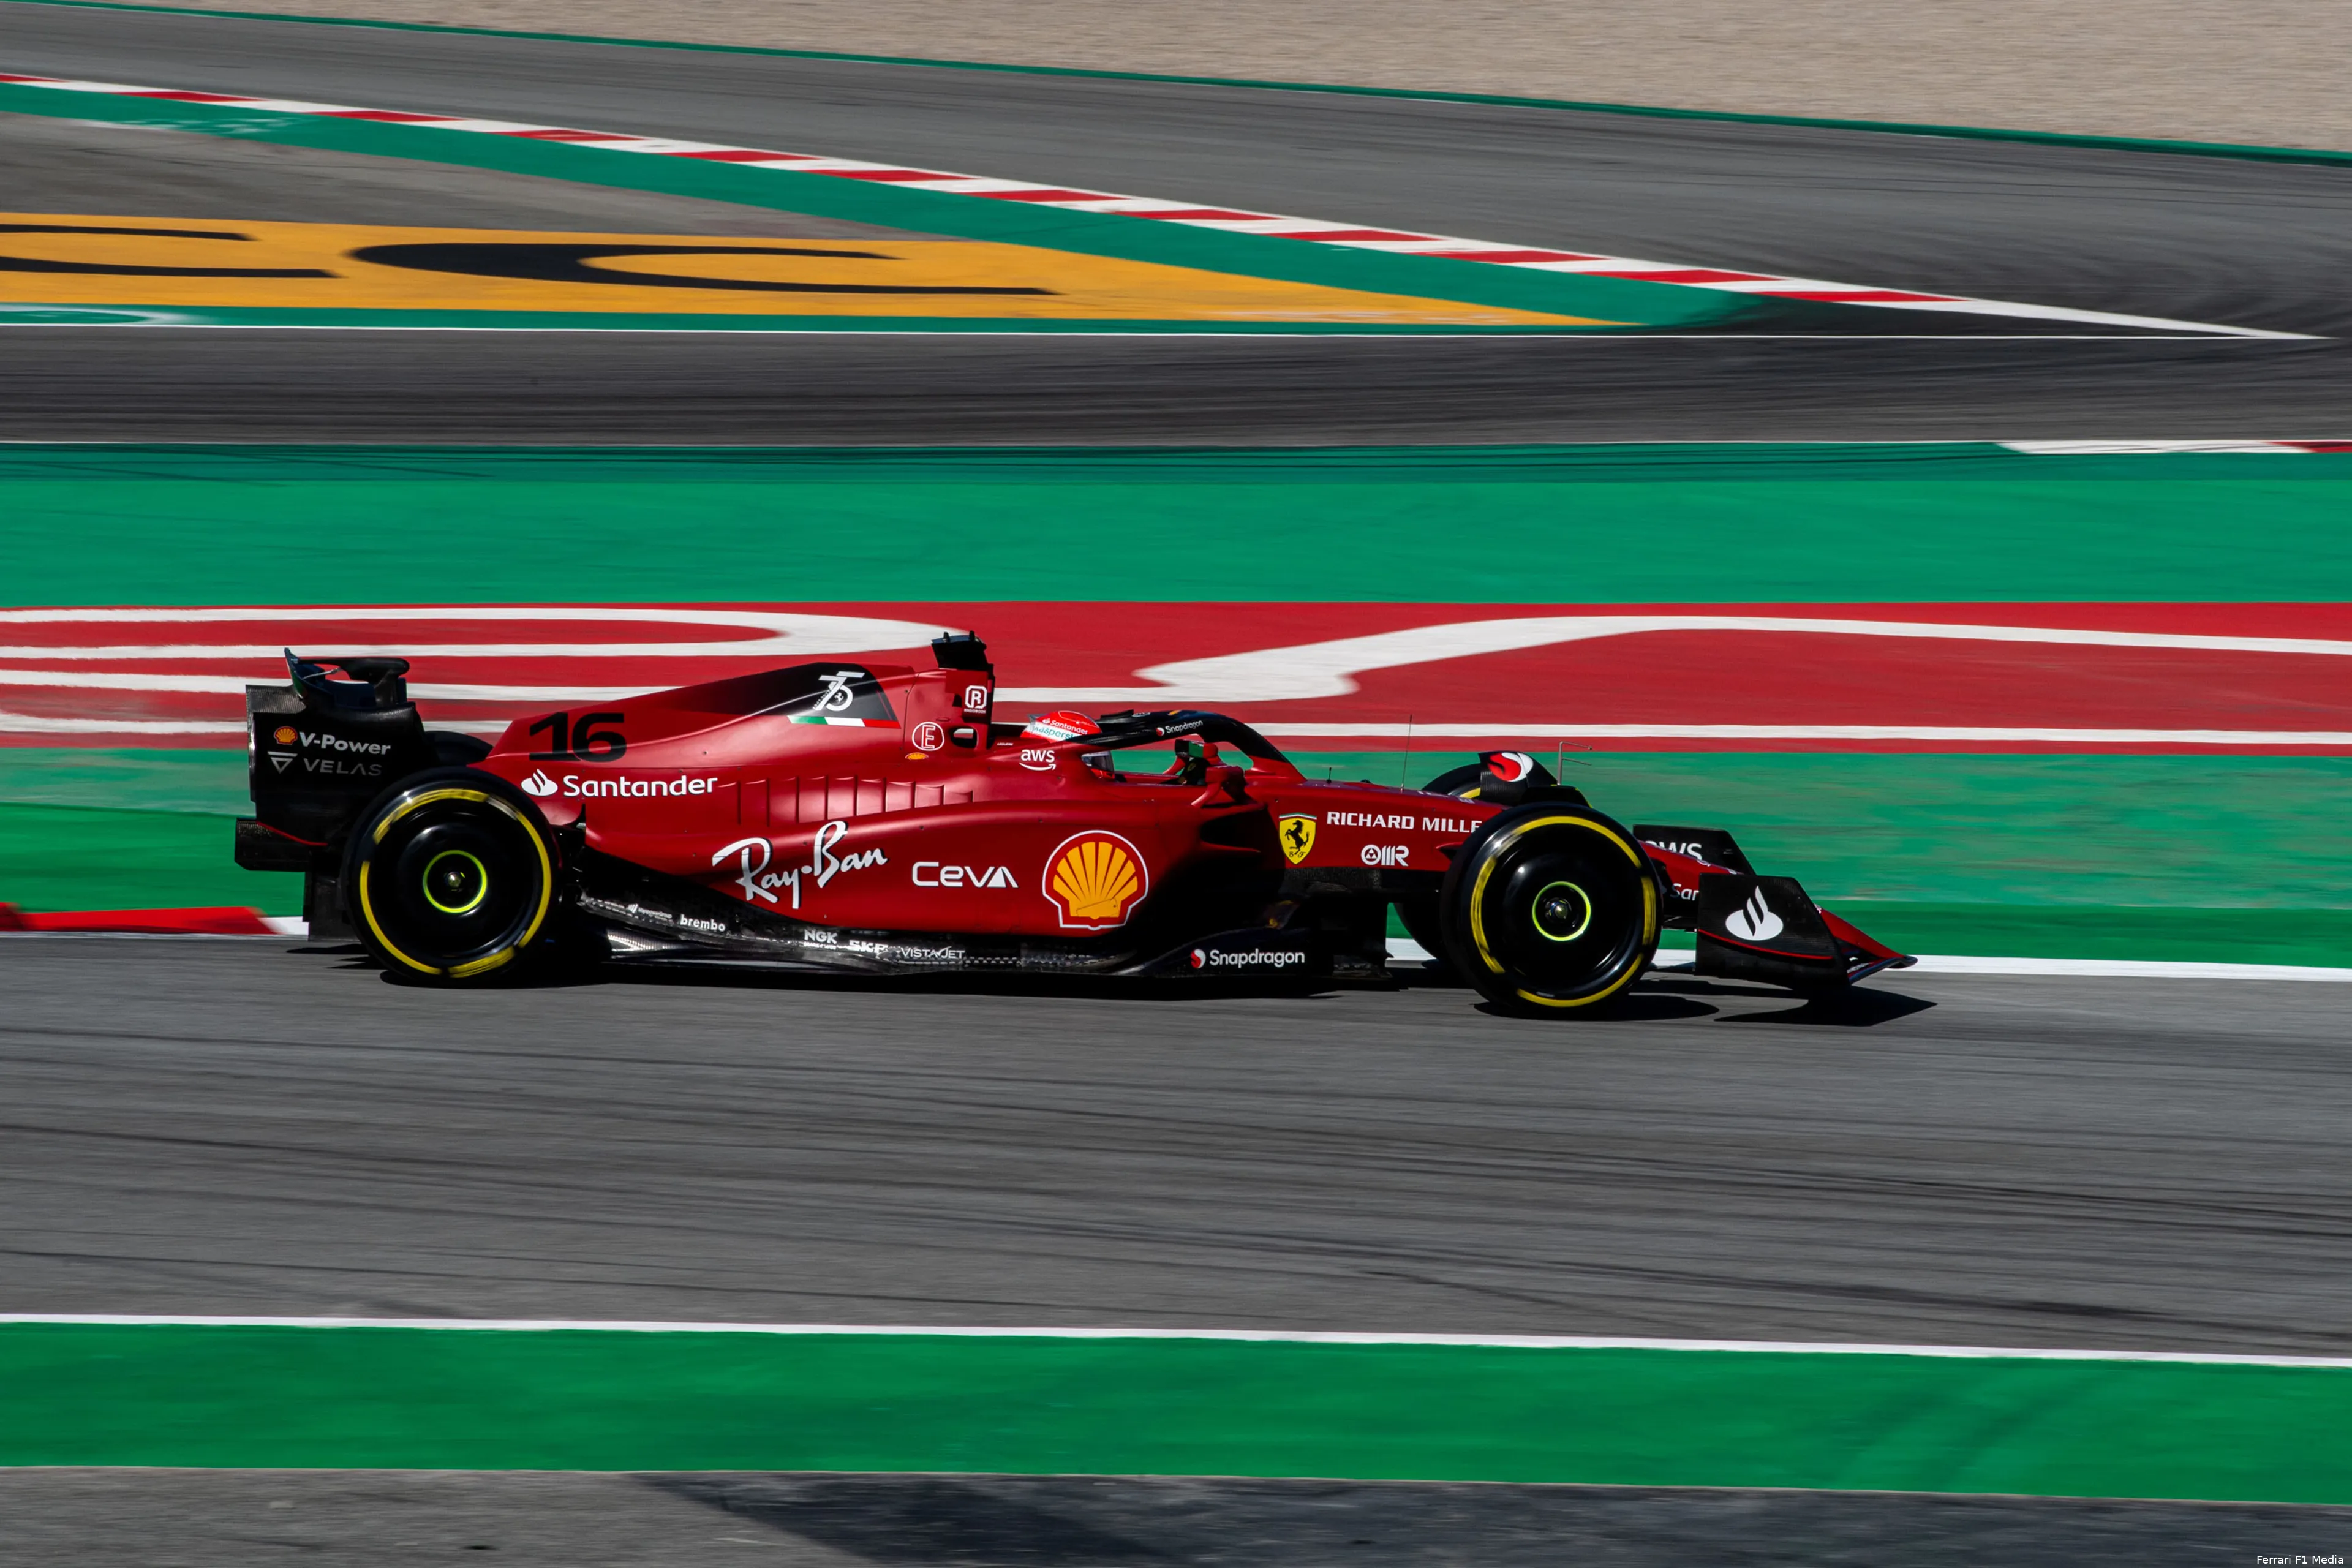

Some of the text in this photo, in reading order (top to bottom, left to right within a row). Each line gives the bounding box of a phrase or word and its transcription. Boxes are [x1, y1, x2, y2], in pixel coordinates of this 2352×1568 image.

[1050, 720, 1088, 736] Santander
[1165, 720, 1204, 734] Snapdragon
[300, 731, 391, 756] V-Power
[529, 712, 627, 763] 16
[1020, 749, 1055, 763] aws
[303, 758, 382, 776] VELAS
[563, 774, 718, 797] Santander
[1327, 811, 1415, 830] RICHARD
[680, 914, 726, 932] brembo
[804, 929, 838, 944] NGK
[1209, 948, 1305, 968] Snapdragon
